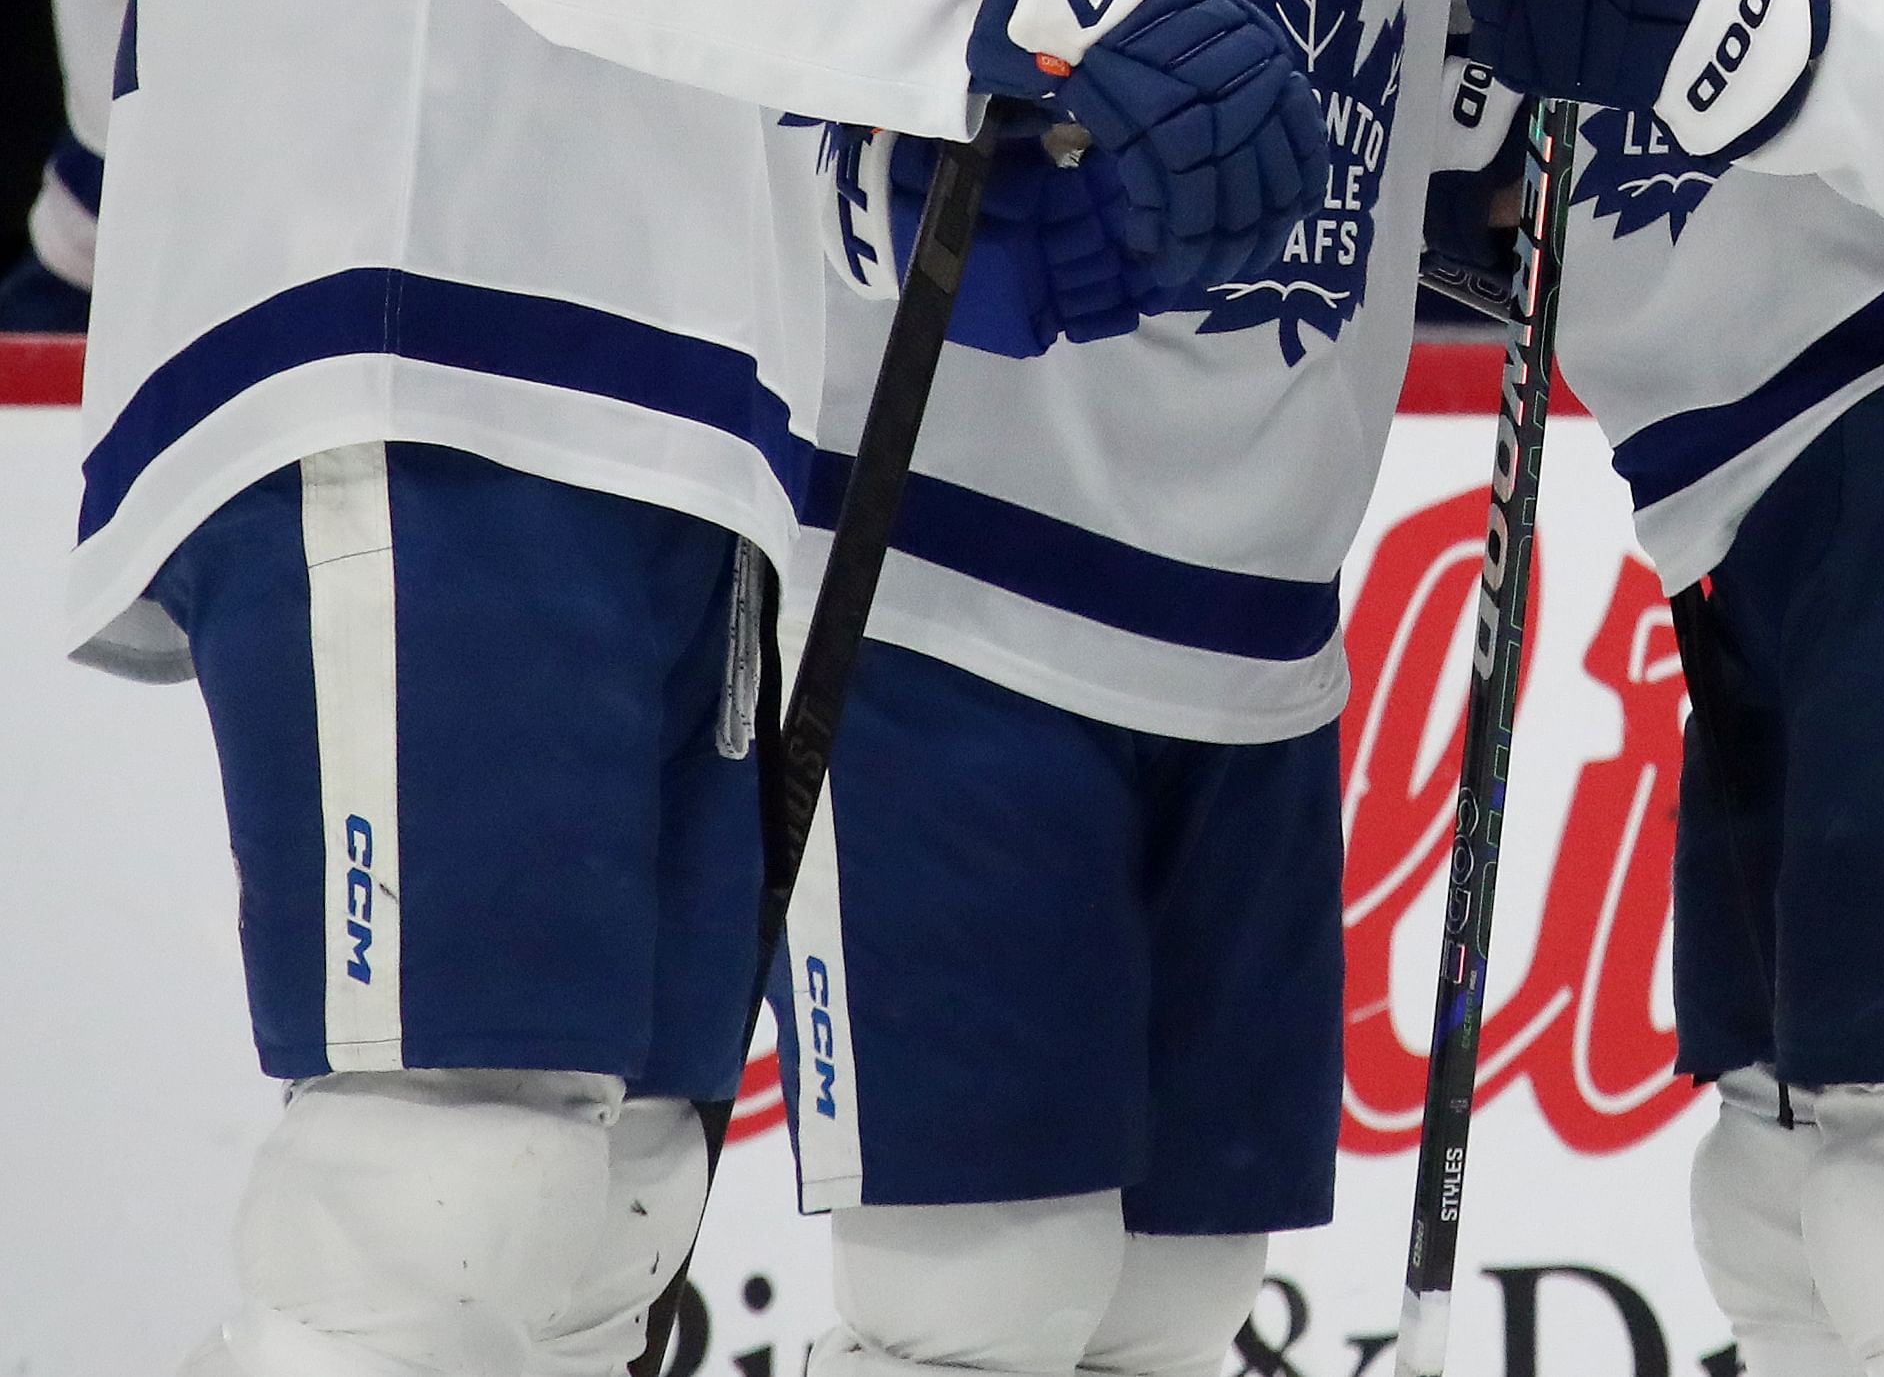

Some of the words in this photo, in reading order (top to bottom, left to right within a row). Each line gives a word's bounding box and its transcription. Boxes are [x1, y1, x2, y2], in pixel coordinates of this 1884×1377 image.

[1283, 219, 1359, 266] AFS
[1324, 164, 1365, 211] LE
[1472, 99, 1556, 681] HERWOOD
[344, 813, 374, 985] CCM
[805, 954, 837, 1120] CCM
[1442, 1147, 1464, 1221] STYLES
